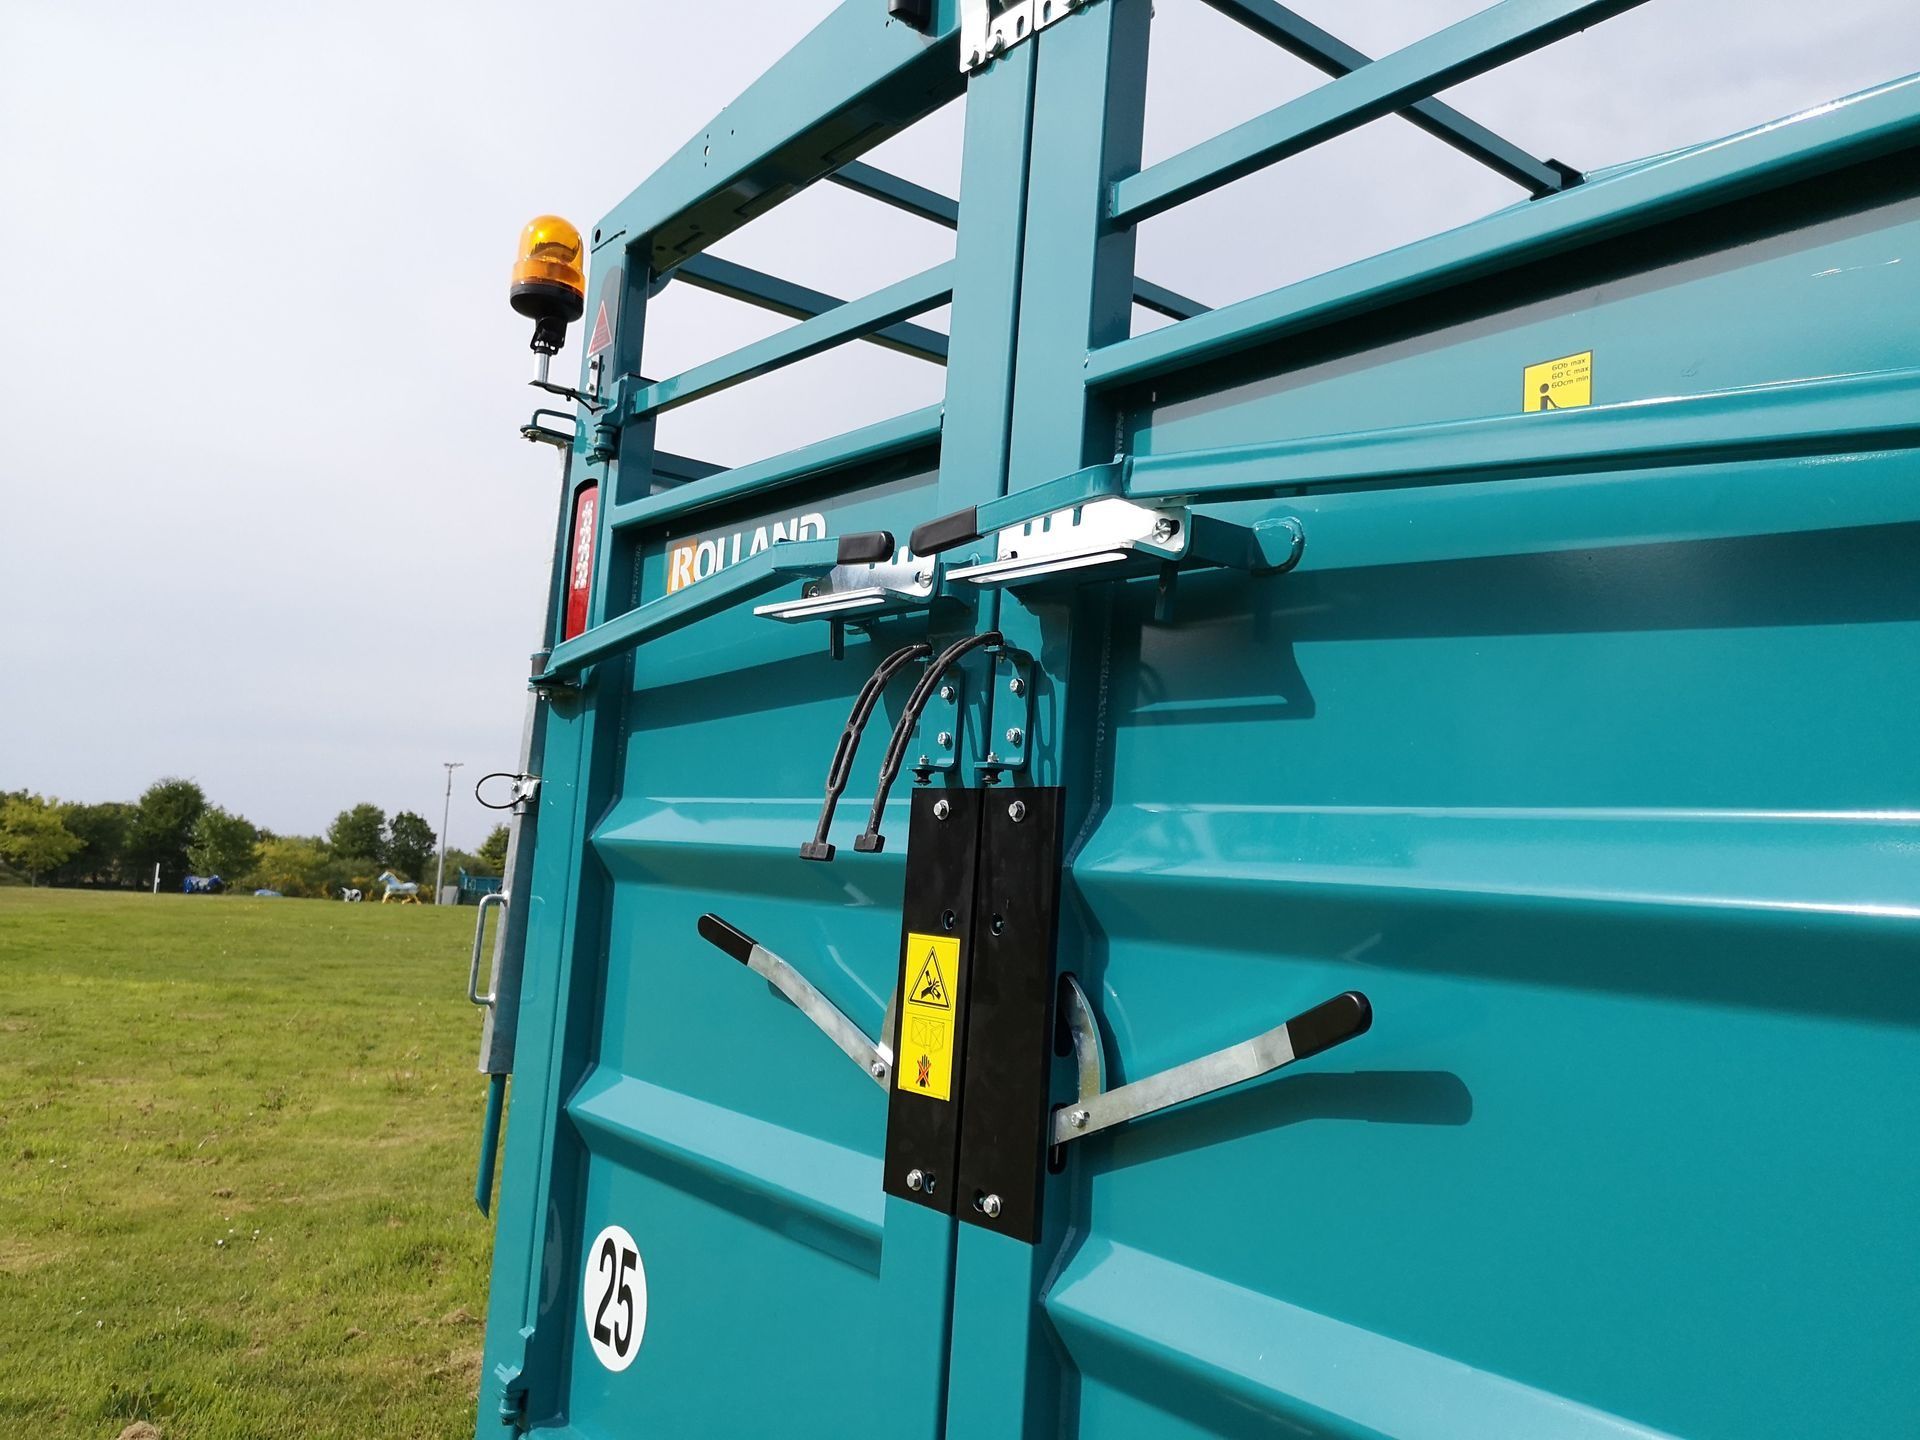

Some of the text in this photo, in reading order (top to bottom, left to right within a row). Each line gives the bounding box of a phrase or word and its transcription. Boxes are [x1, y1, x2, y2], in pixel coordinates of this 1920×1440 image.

[1570, 358, 1586, 367] max
[1573, 366, 1589, 374] max
[1551, 375, 1589, 389] 60cm min
[593, 1237, 637, 1358] 25
